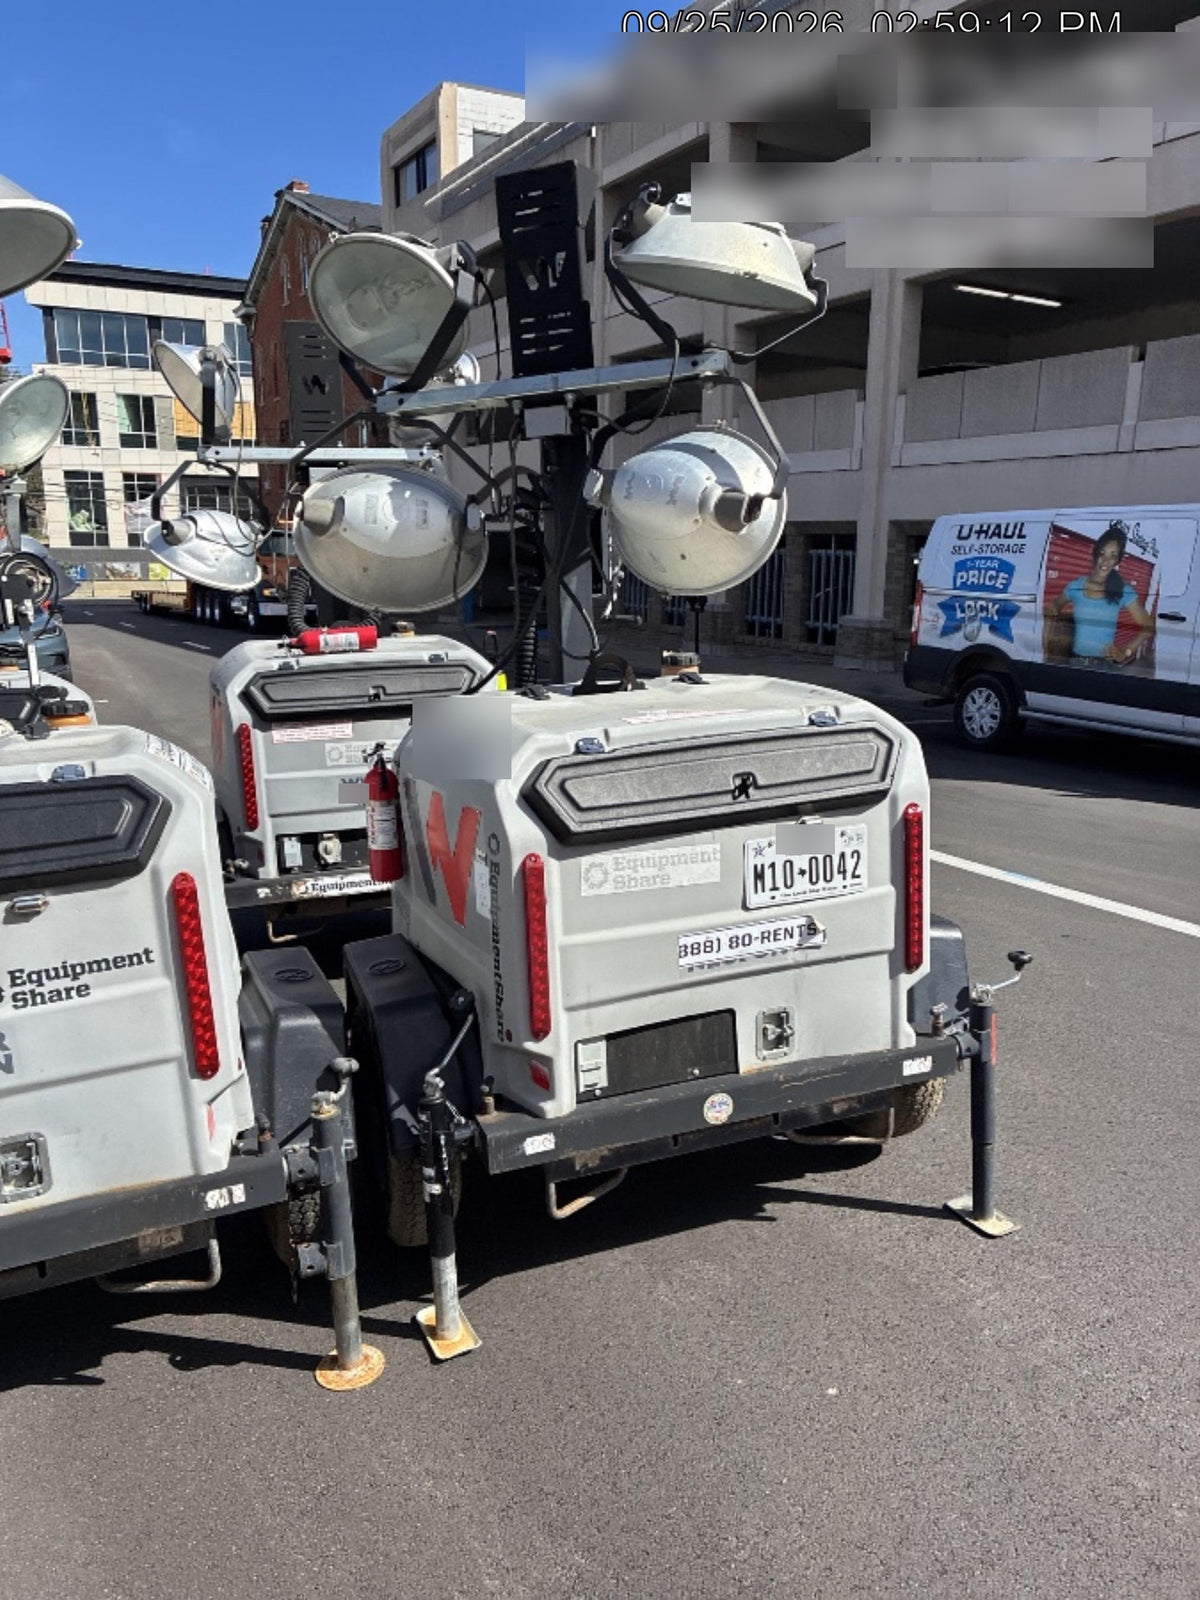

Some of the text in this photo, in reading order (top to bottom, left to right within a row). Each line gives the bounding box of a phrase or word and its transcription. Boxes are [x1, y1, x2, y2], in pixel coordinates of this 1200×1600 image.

[957, 522, 1027, 541] U-HAUL
[951, 543, 1027, 555] SELF-STORAGE
[956, 569, 1009, 589] PRICE
[955, 600, 1000, 621] LOCK
[612, 847, 721, 873] Equipment
[612, 873, 672, 890] Share
[728, 922, 818, 950] 80-RENTS
[7, 947, 155, 988] Equipment
[11, 983, 91, 1010] Share
